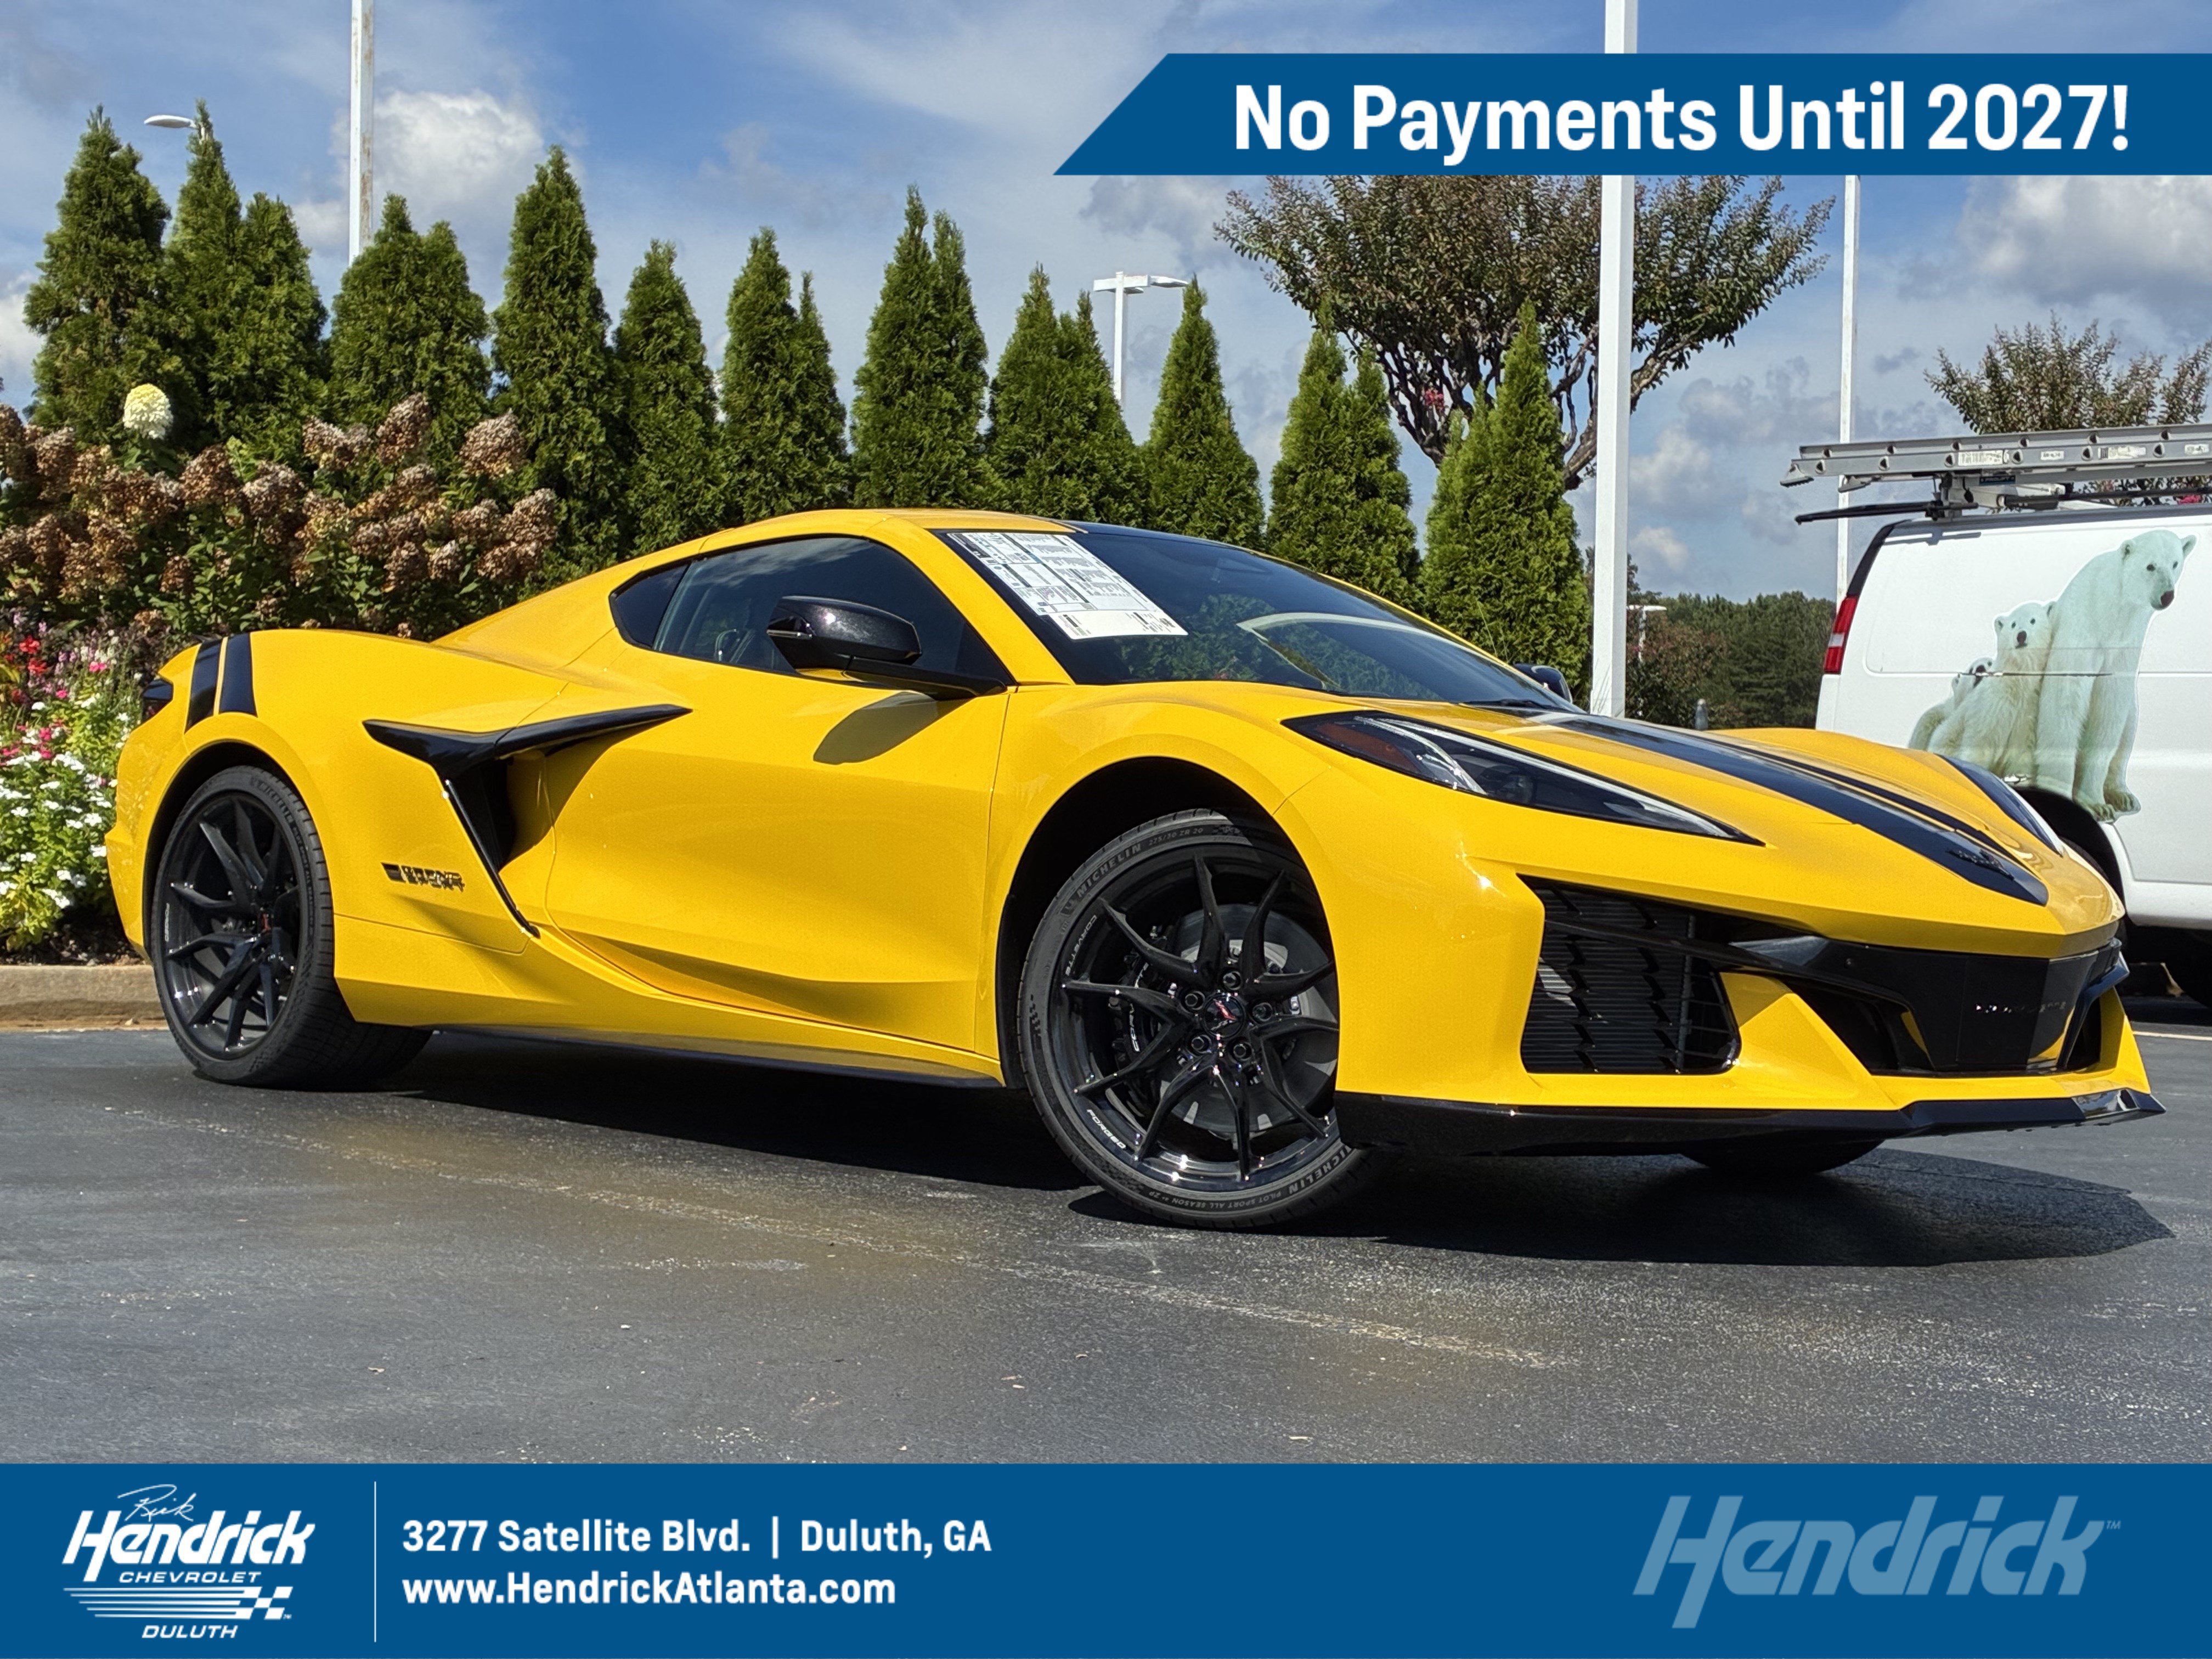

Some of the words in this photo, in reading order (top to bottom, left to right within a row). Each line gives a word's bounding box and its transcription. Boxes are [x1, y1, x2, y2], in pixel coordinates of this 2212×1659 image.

[1076, 843, 1141, 898] MICHELIN
[1065, 915, 1097, 976] CORVETTE
[1087, 1109, 1126, 1149] FORGED
[1171, 1198, 1206, 1208] SEASON
[1227, 1200, 1256, 1209] SPORT
[1258, 1191, 1282, 1203] PILOT
